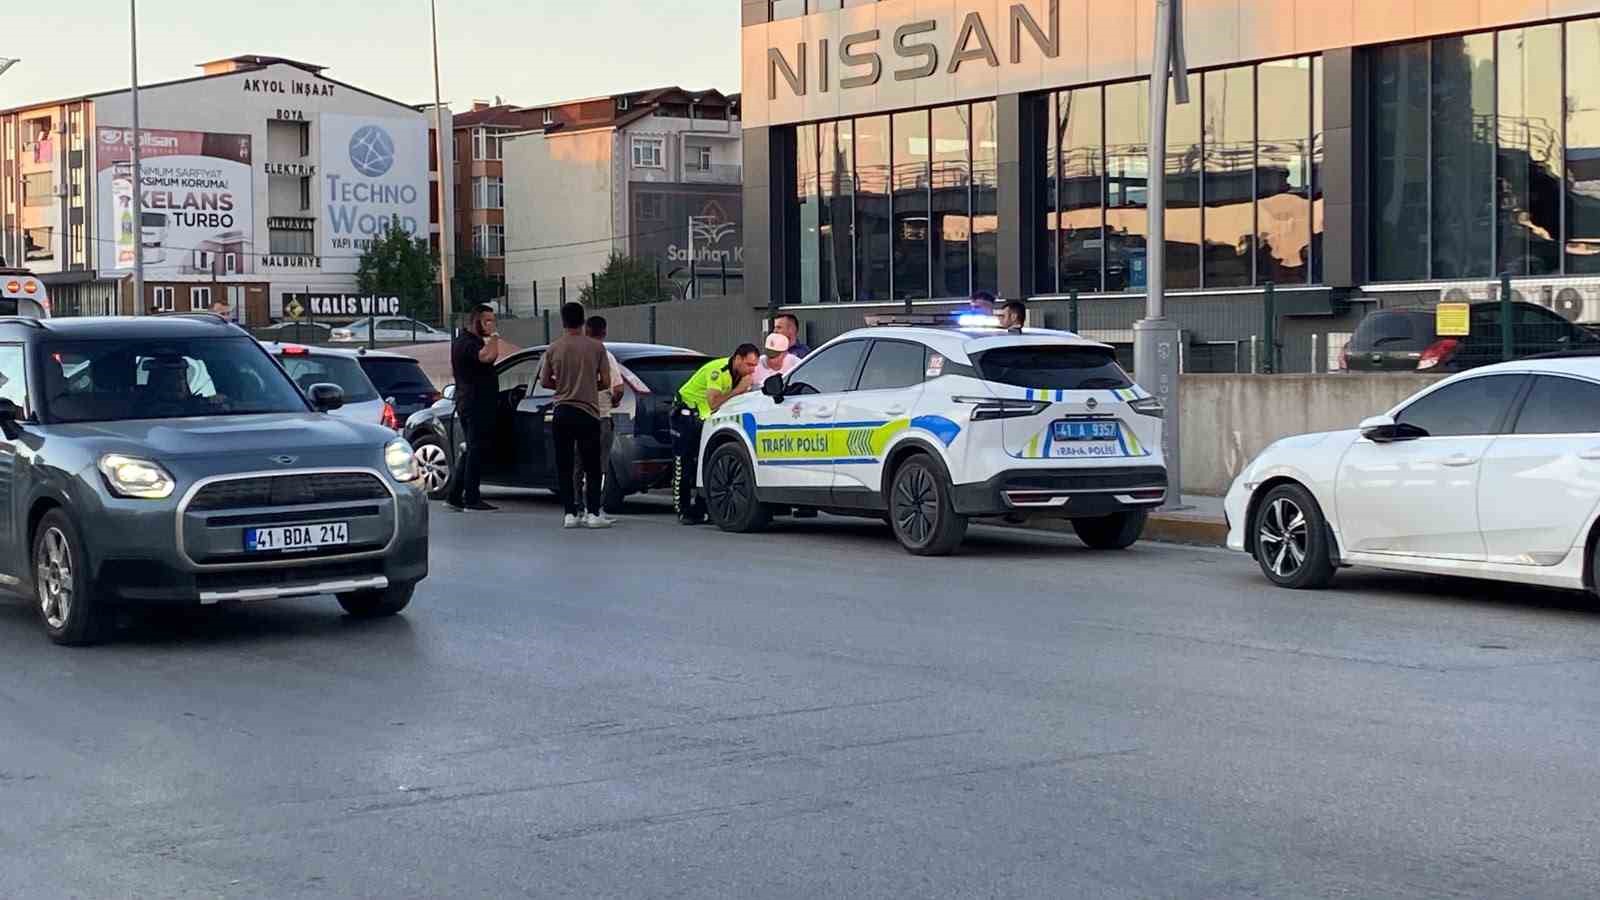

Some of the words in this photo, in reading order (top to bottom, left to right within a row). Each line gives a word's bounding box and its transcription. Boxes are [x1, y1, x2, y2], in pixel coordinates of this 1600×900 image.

[767, 0, 1060, 100] NISSAN
[243, 79, 285, 93] AKYOL
[291, 80, 335, 97] İNŞAAT
[276, 109, 304, 121] BOYA
[326, 174, 417, 203] TECHNO
[173, 212, 234, 228] TURBO
[327, 205, 417, 235] WORD
[667, 244, 730, 262] Sauhan
[310, 294, 357, 314] KALİS
[361, 294, 399, 316] VİNÇ
[1060, 424, 1072, 437] 41
[1079, 424, 1086, 437] A
[761, 437, 793, 453] TRAFİK
[797, 434, 829, 452] POLİSİ
[257, 530, 274, 547] 41
[283, 527, 312, 546] BDA
[320, 524, 345, 542] 214
